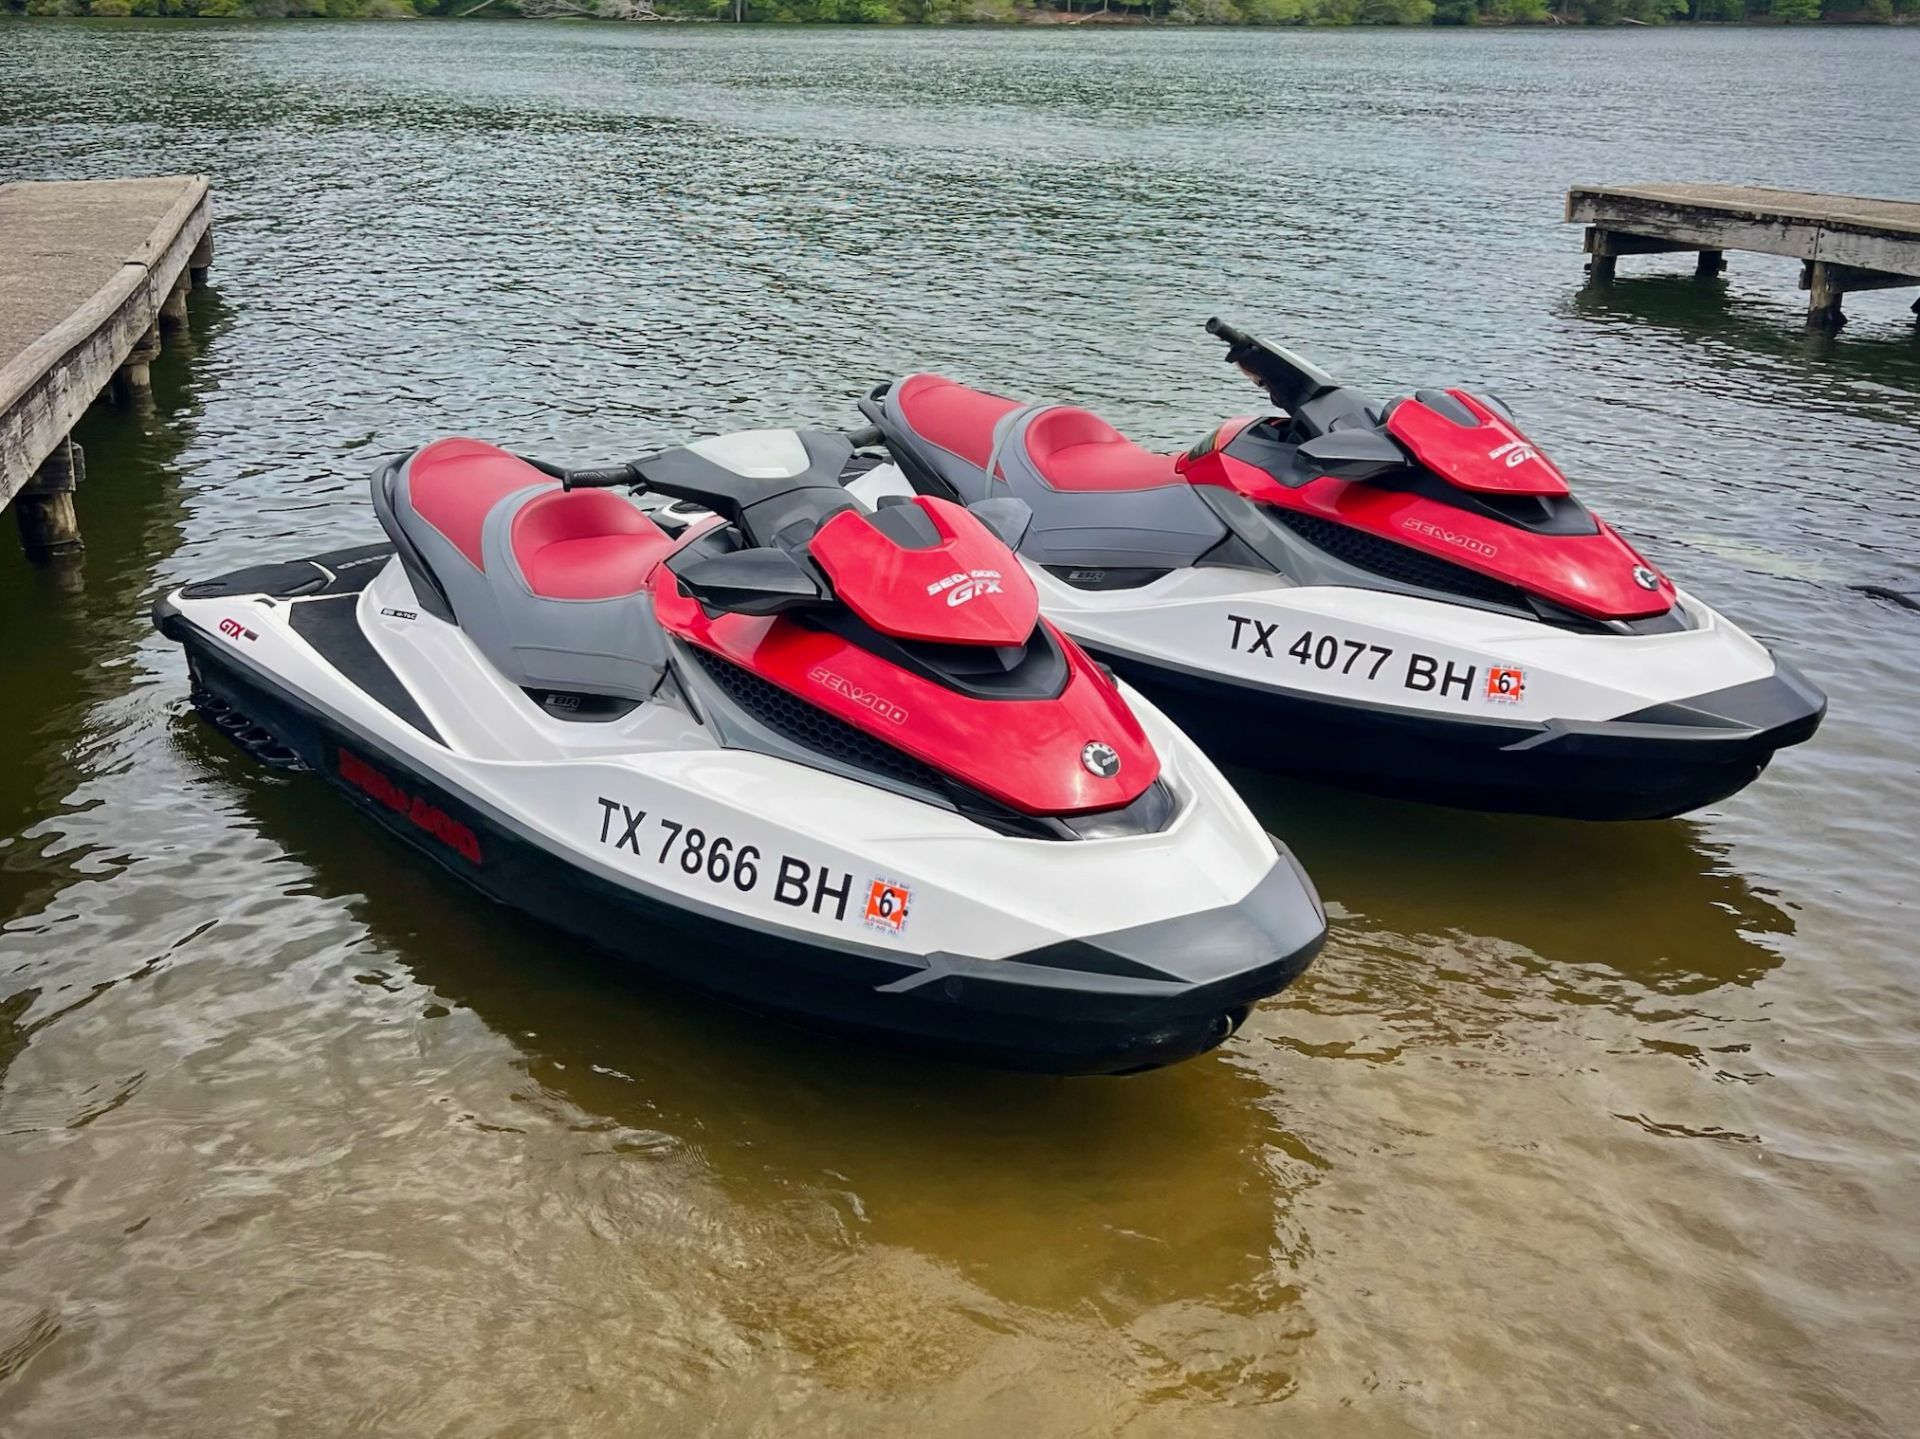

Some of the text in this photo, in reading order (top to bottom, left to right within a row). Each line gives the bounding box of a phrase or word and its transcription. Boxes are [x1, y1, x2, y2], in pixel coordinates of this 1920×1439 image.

[947, 579, 1004, 607] GTX
[219, 618, 245, 640] GTX
[1227, 614, 1476, 700] TX 4077 BH
[1498, 672, 1511, 693] 6
[598, 797, 853, 921] TX 7866 BH
[879, 888, 894, 917] 6
